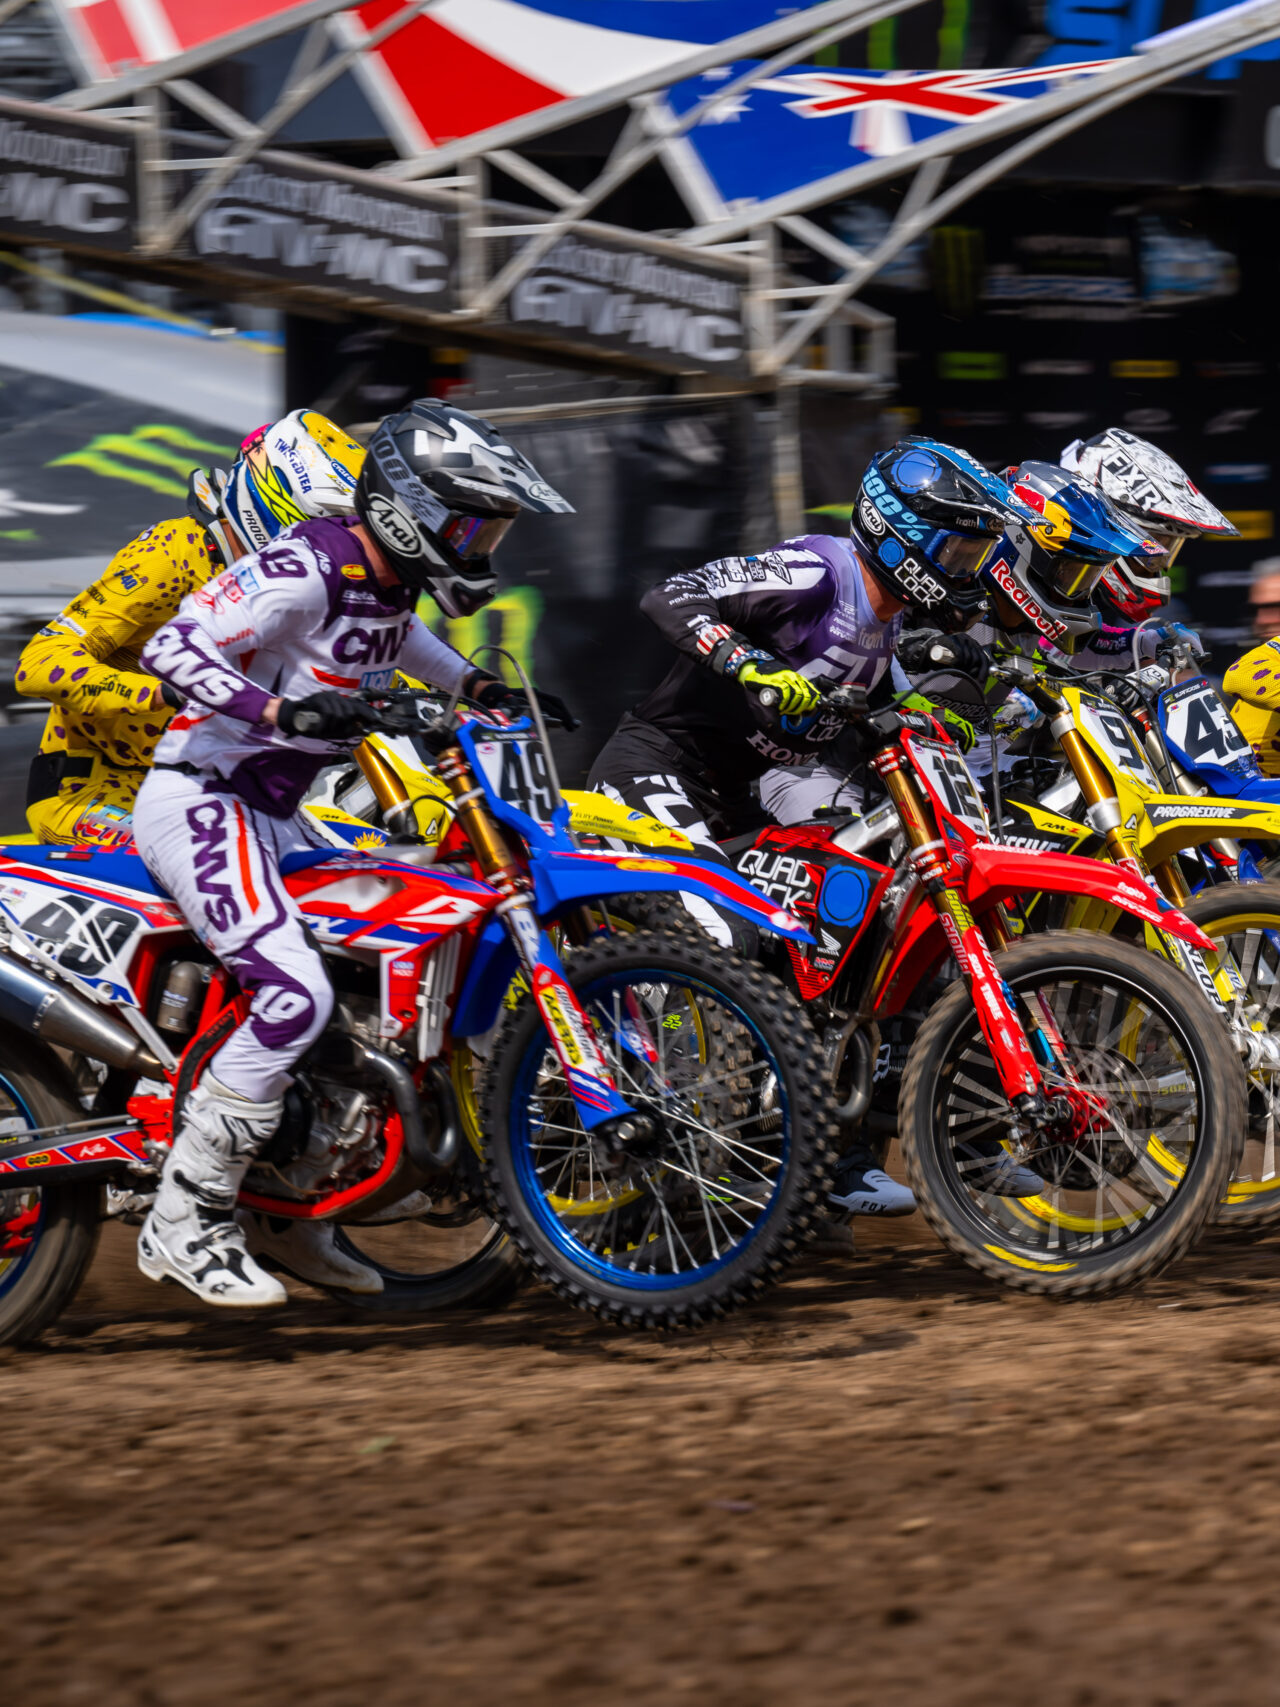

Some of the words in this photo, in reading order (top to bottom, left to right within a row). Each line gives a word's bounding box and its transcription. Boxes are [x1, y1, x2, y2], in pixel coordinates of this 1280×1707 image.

[298, 472, 313, 495] TEA
[1103, 452, 1162, 510] FXR
[861, 500, 883, 533] Arai
[863, 469, 931, 541] 100%
[371, 508, 417, 549] Arai
[894, 567, 938, 610] LOCK
[904, 558, 946, 599] QUAD
[990, 558, 1031, 608] Red
[500, 741, 556, 822] 49
[1041, 821, 1079, 834] RM-Z
[1152, 805, 1236, 819] PROGRESSIVE
[737, 850, 811, 888] QUAD
[940, 912, 971, 975] SHOWA
